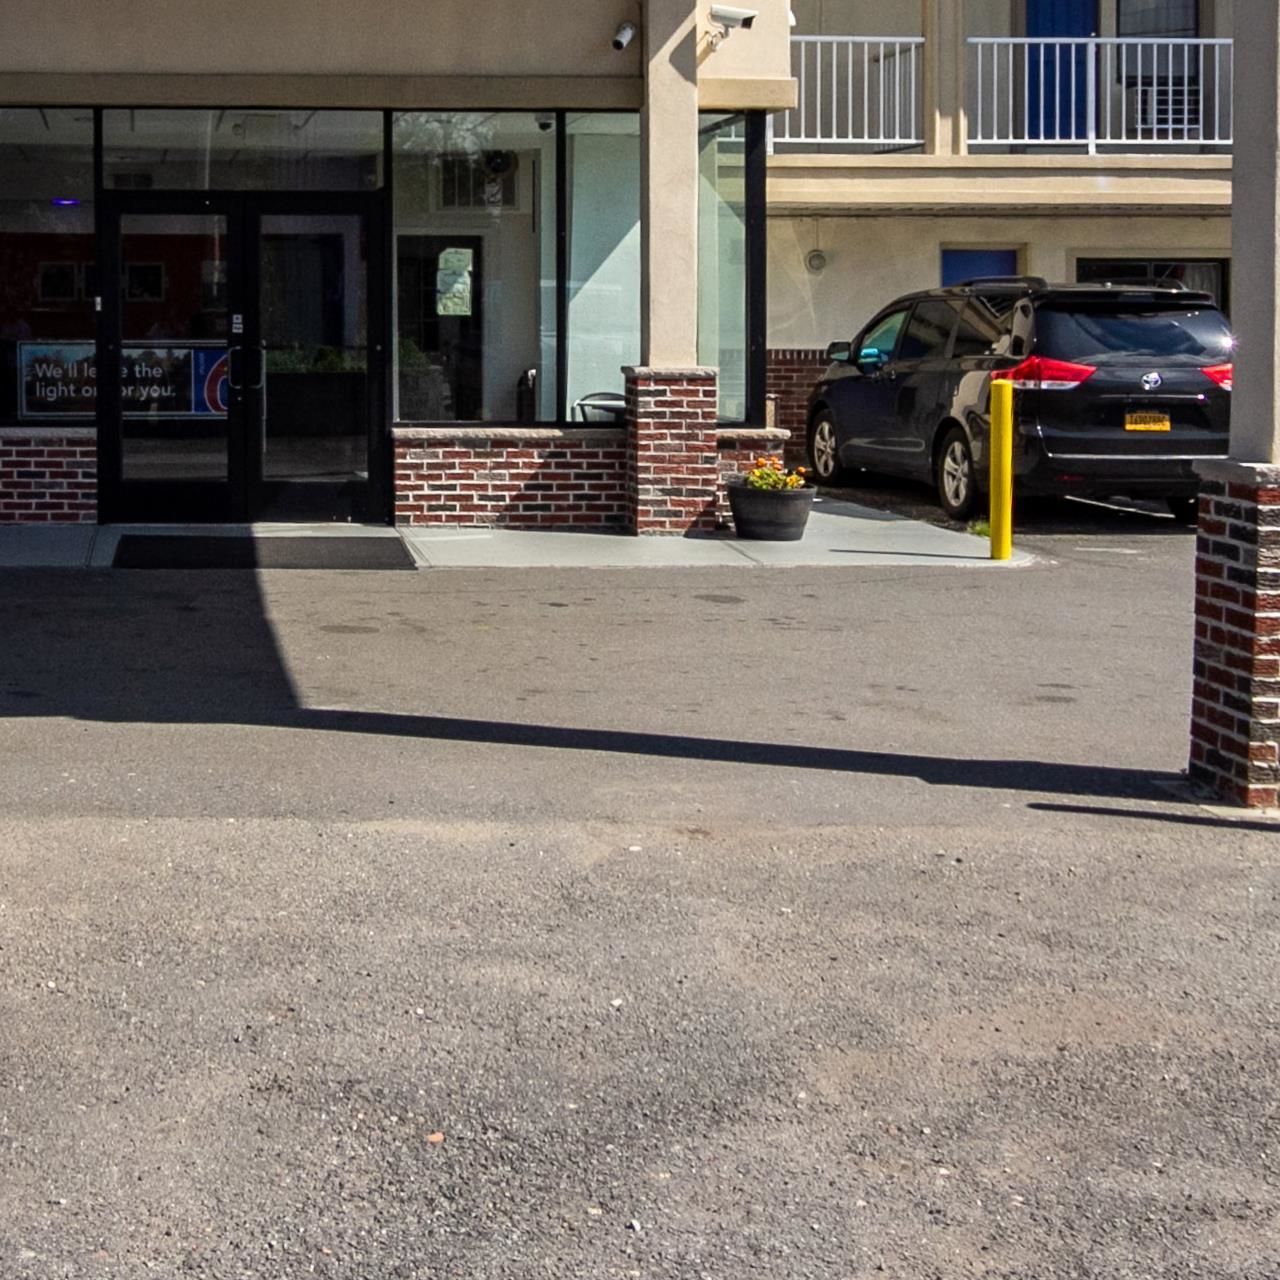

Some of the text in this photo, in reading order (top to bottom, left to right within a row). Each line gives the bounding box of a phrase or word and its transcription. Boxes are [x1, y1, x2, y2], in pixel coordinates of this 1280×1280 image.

[34, 361, 163, 378] We'll lee the
[35, 381, 76, 401] light
[139, 385, 177, 401] you.
